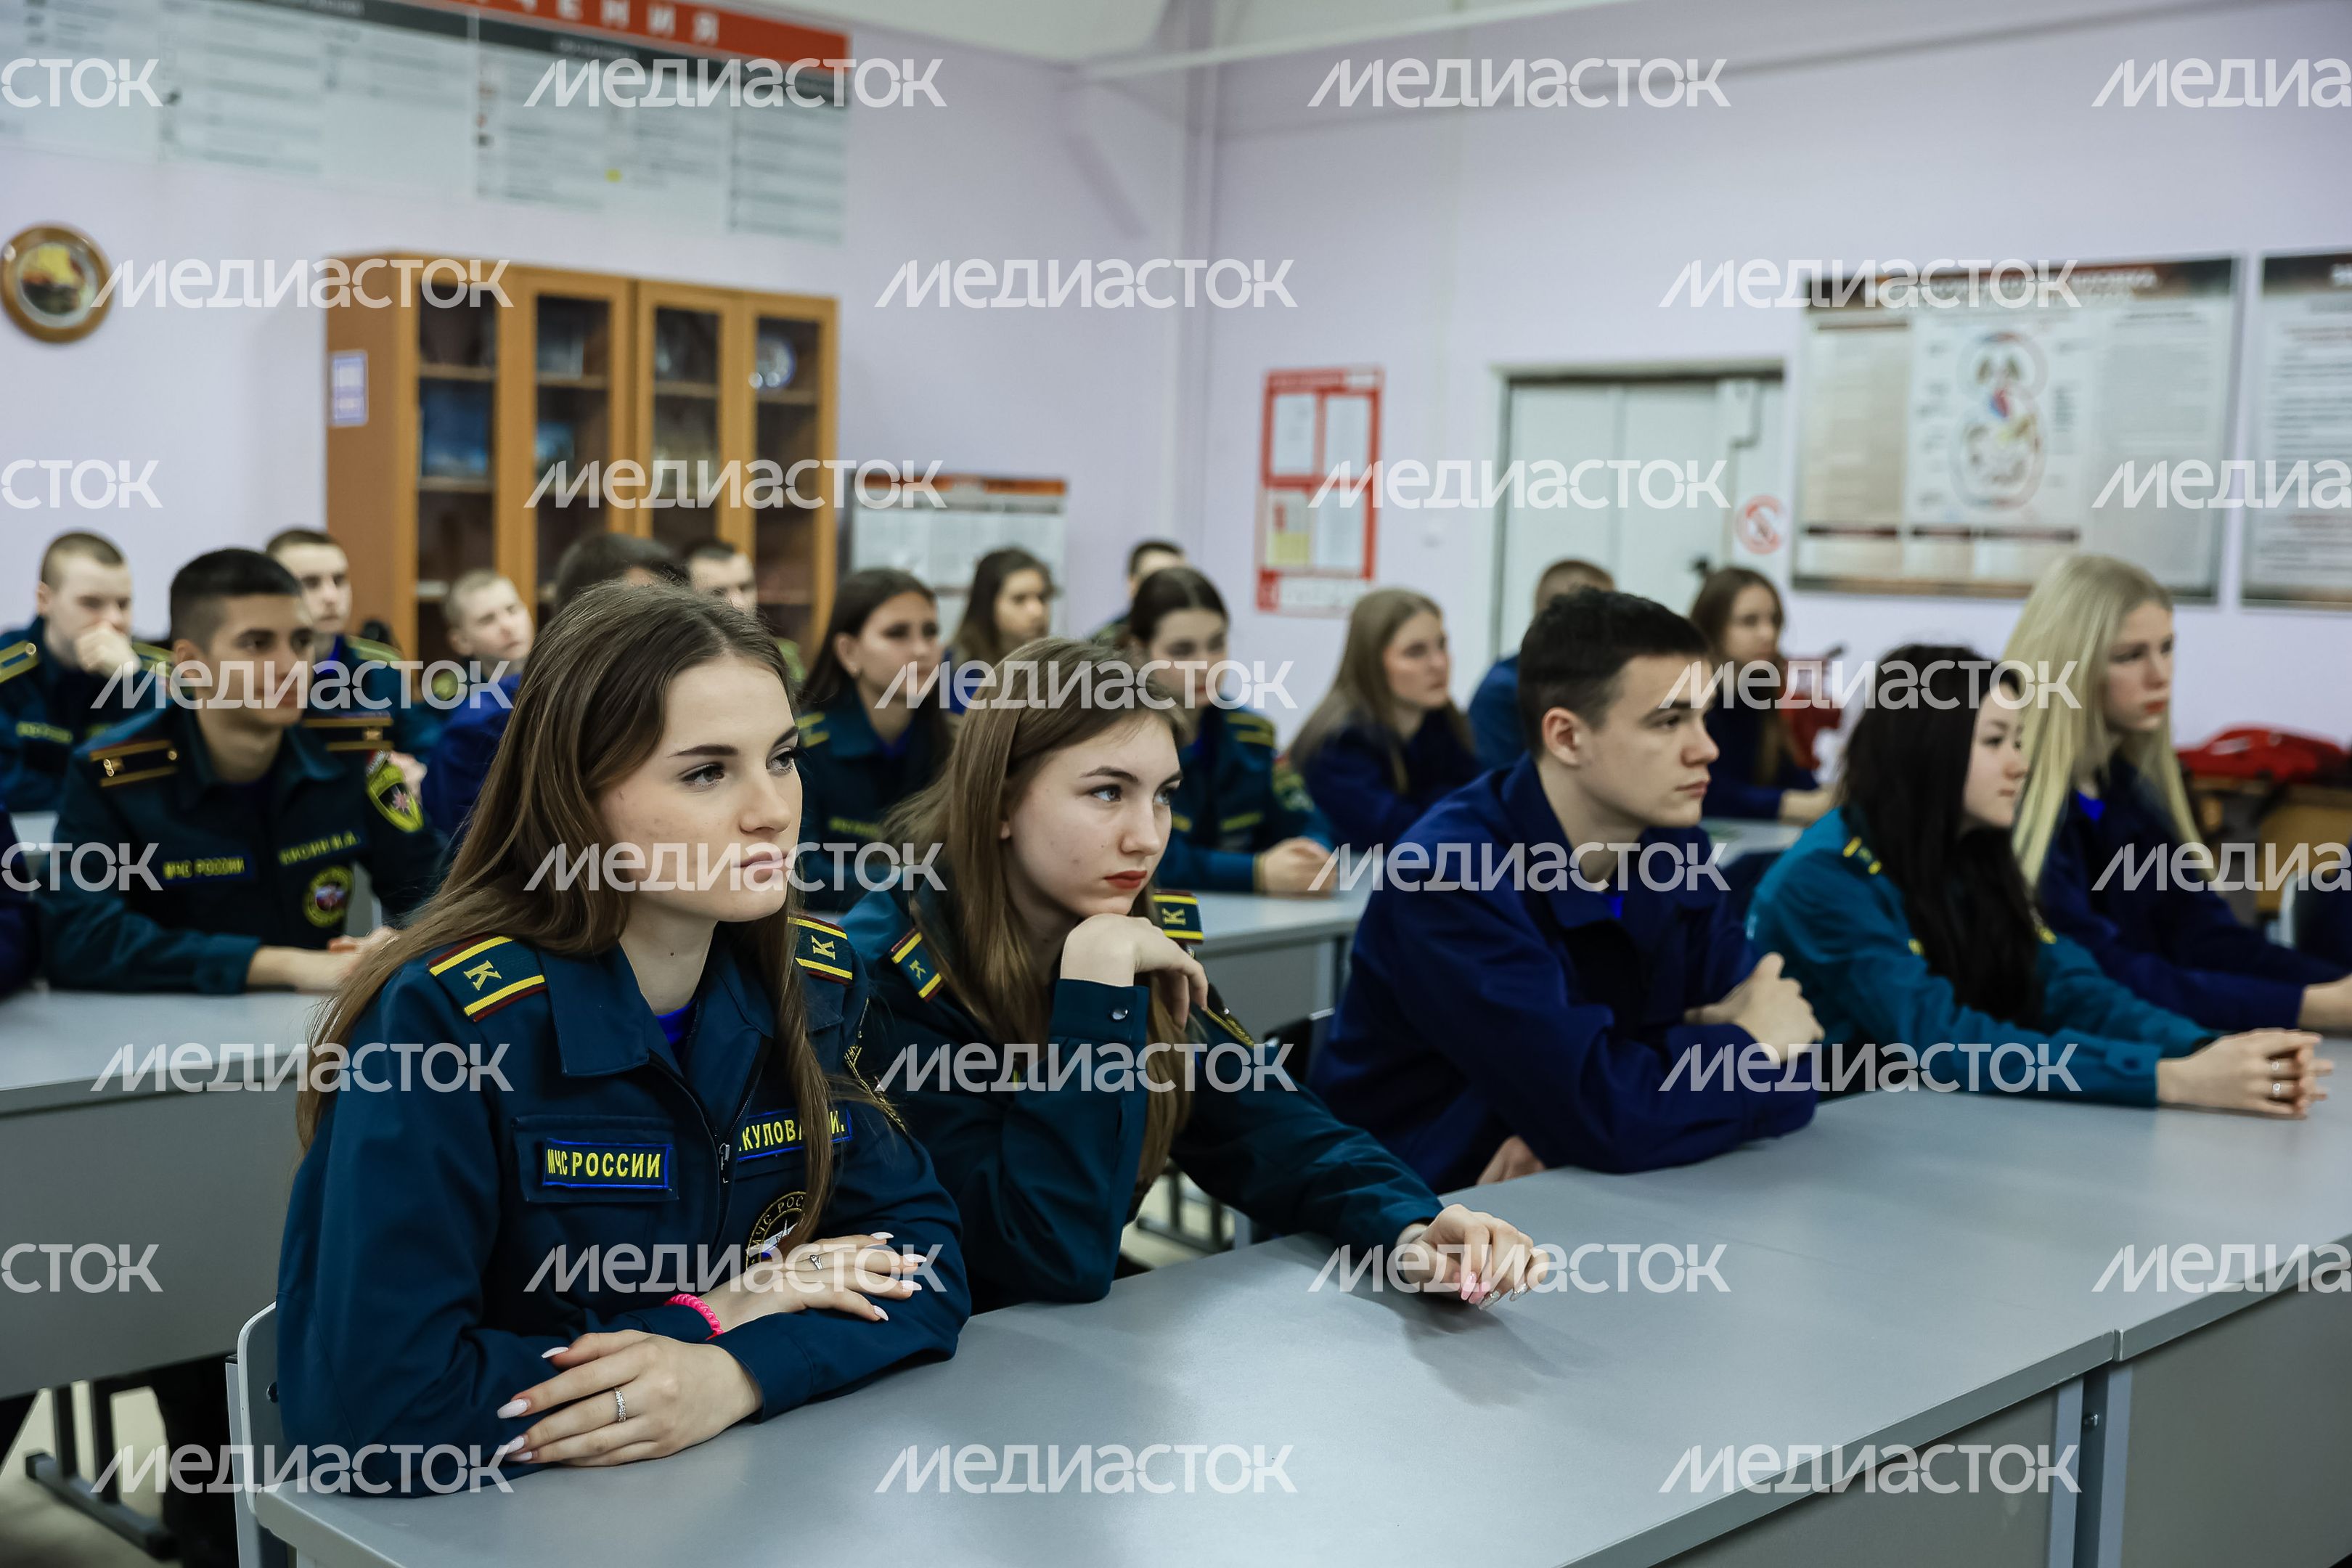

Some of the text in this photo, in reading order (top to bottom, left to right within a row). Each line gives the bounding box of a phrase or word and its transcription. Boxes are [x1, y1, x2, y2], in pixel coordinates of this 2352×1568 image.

[1161, 907, 1186, 926] К
[811, 935, 836, 960] К
[463, 960, 502, 991] К
[909, 959, 926, 980] К
[547, 1148, 661, 1178] МЧС РОССИИ
[777, 1196, 804, 1214] РОС
